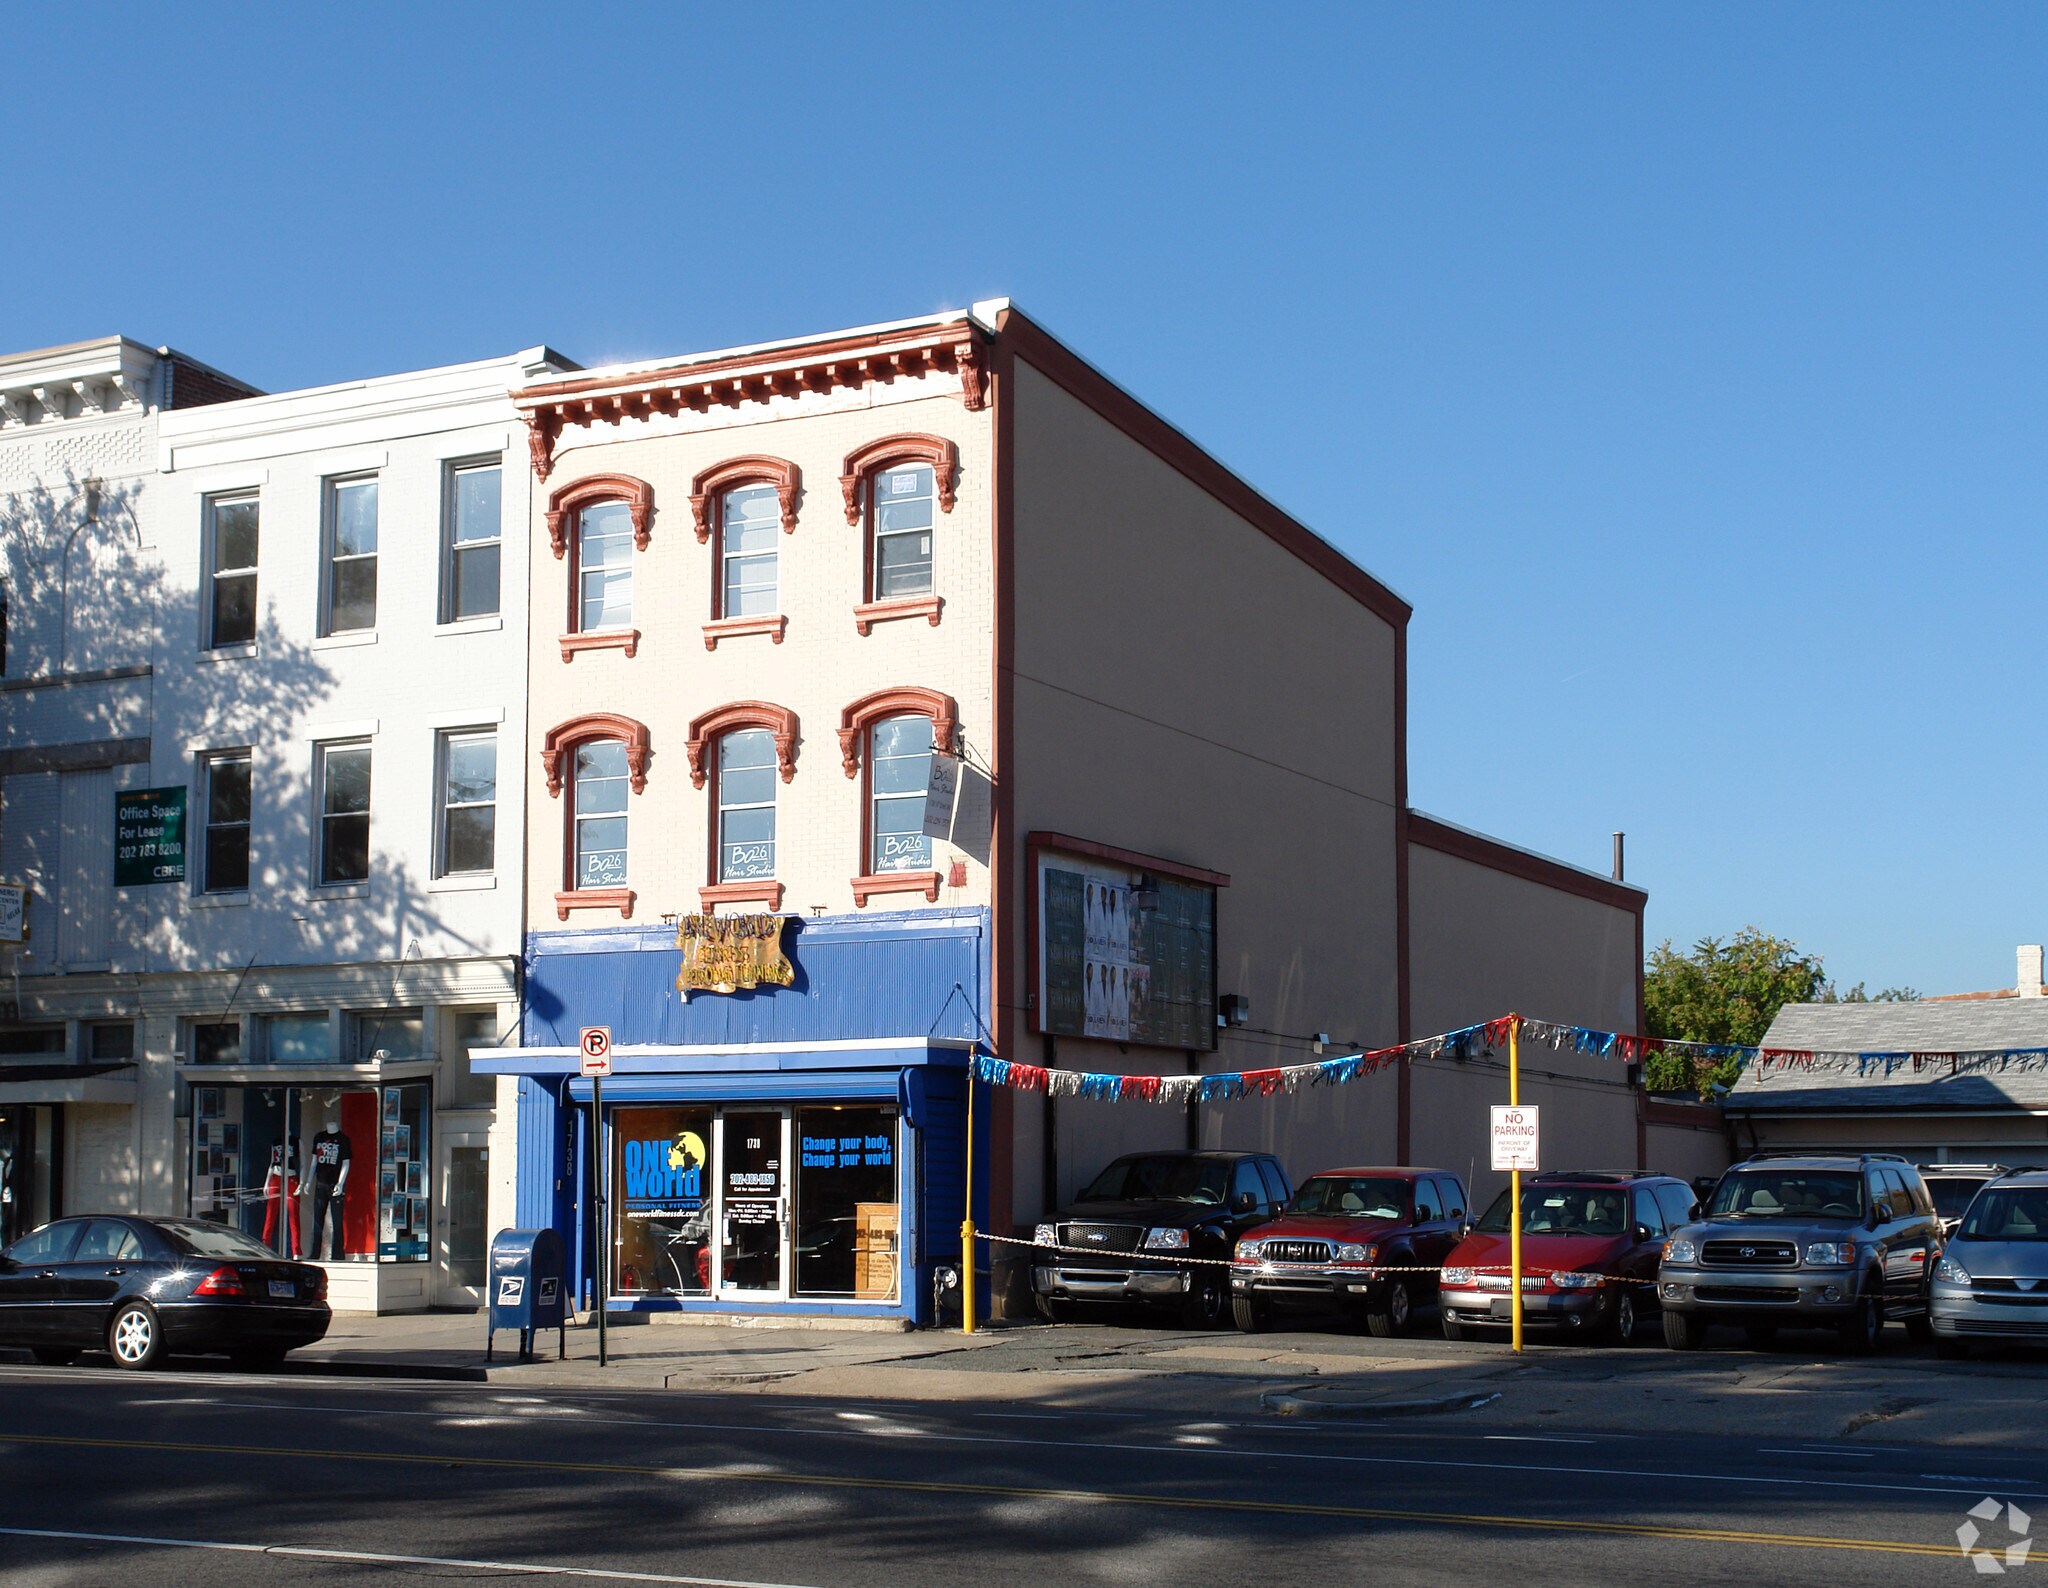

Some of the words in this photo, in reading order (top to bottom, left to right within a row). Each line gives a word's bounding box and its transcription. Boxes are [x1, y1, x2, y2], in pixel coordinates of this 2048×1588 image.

[120, 807, 149, 820] Office
[152, 805, 181, 819] Space
[120, 827, 135, 839] For
[137, 825, 165, 838] Lease
[119, 846, 136, 859] 202
[158, 842, 181, 856] 8200
[153, 865, 184, 877] CBRE
[1505, 1114, 1523, 1124] NO
[1495, 1125, 1535, 1136] PARKING
[803, 1137, 836, 1152] Change
[839, 1137, 862, 1152] your
[865, 1135, 891, 1151] body,
[625, 1140, 672, 1172] ONE
[802, 1153, 835, 1168] Change
[839, 1154, 860, 1168] your
[865, 1151, 891, 1165] world
